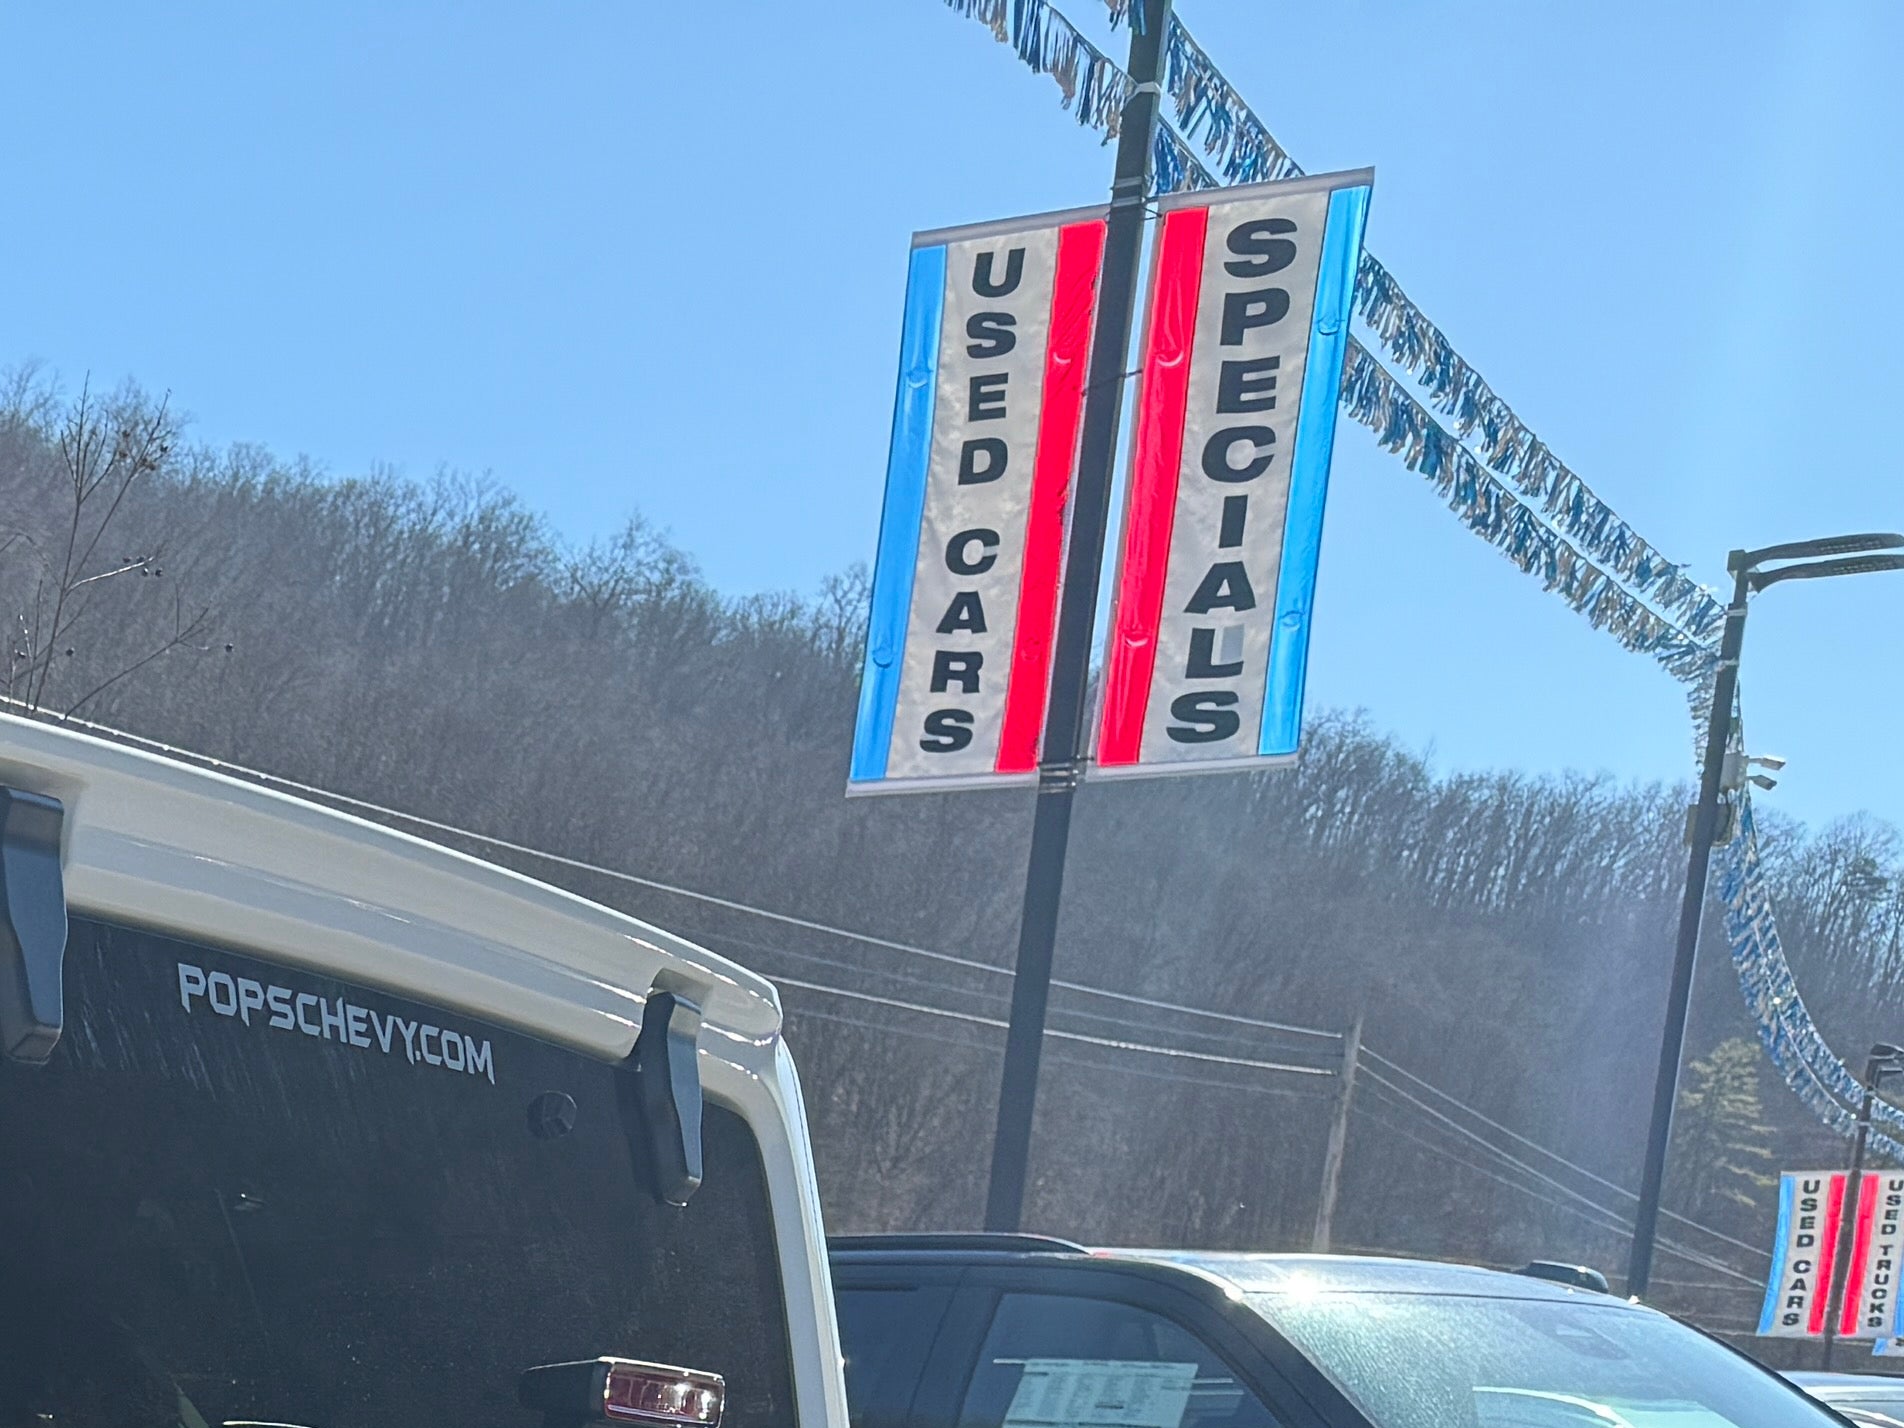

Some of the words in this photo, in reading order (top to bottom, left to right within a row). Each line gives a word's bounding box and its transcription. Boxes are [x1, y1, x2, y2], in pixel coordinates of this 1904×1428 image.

[958, 247, 1026, 486] USED
[1165, 217, 1299, 745] SPECIALS
[919, 527, 1001, 754] CARS
[177, 962, 495, 1085] POPSCHEVY.COM
[1796, 1179, 1821, 1248] USED
[1881, 1179, 1904, 1236] USED
[1782, 1259, 1812, 1327] CARS
[1867, 1244, 1894, 1328] TRUCKS
